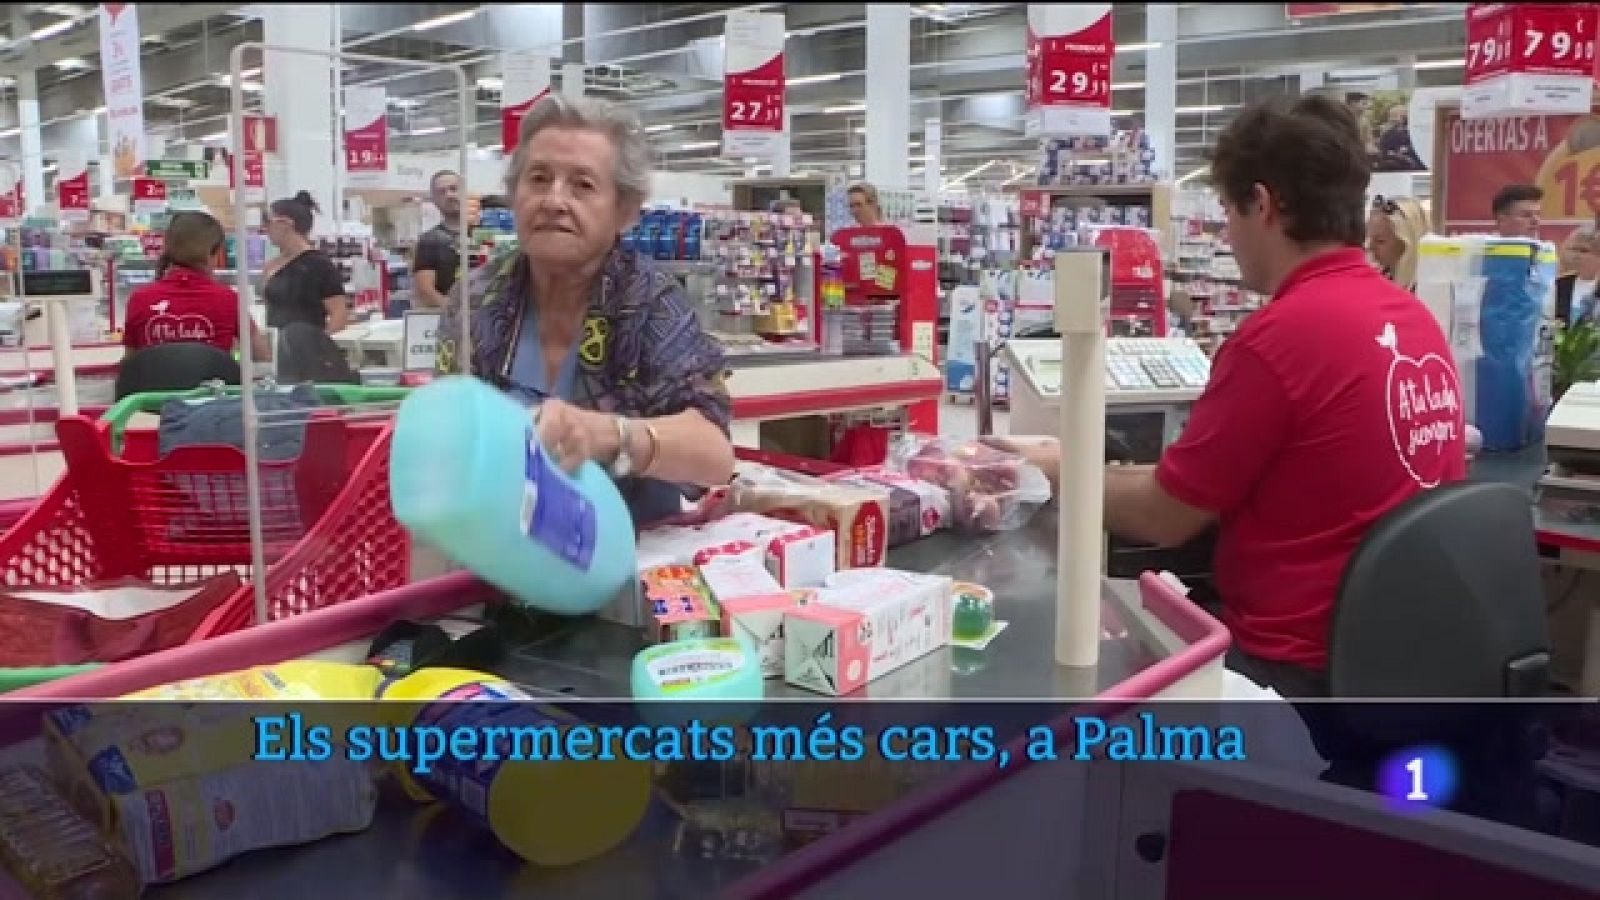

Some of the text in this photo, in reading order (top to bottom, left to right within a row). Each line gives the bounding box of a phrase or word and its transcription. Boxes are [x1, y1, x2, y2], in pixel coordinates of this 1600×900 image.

[1049, 68, 1088, 95] 29
[730, 101, 763, 121] 27
[1452, 113, 1549, 154] OFERTAS A
